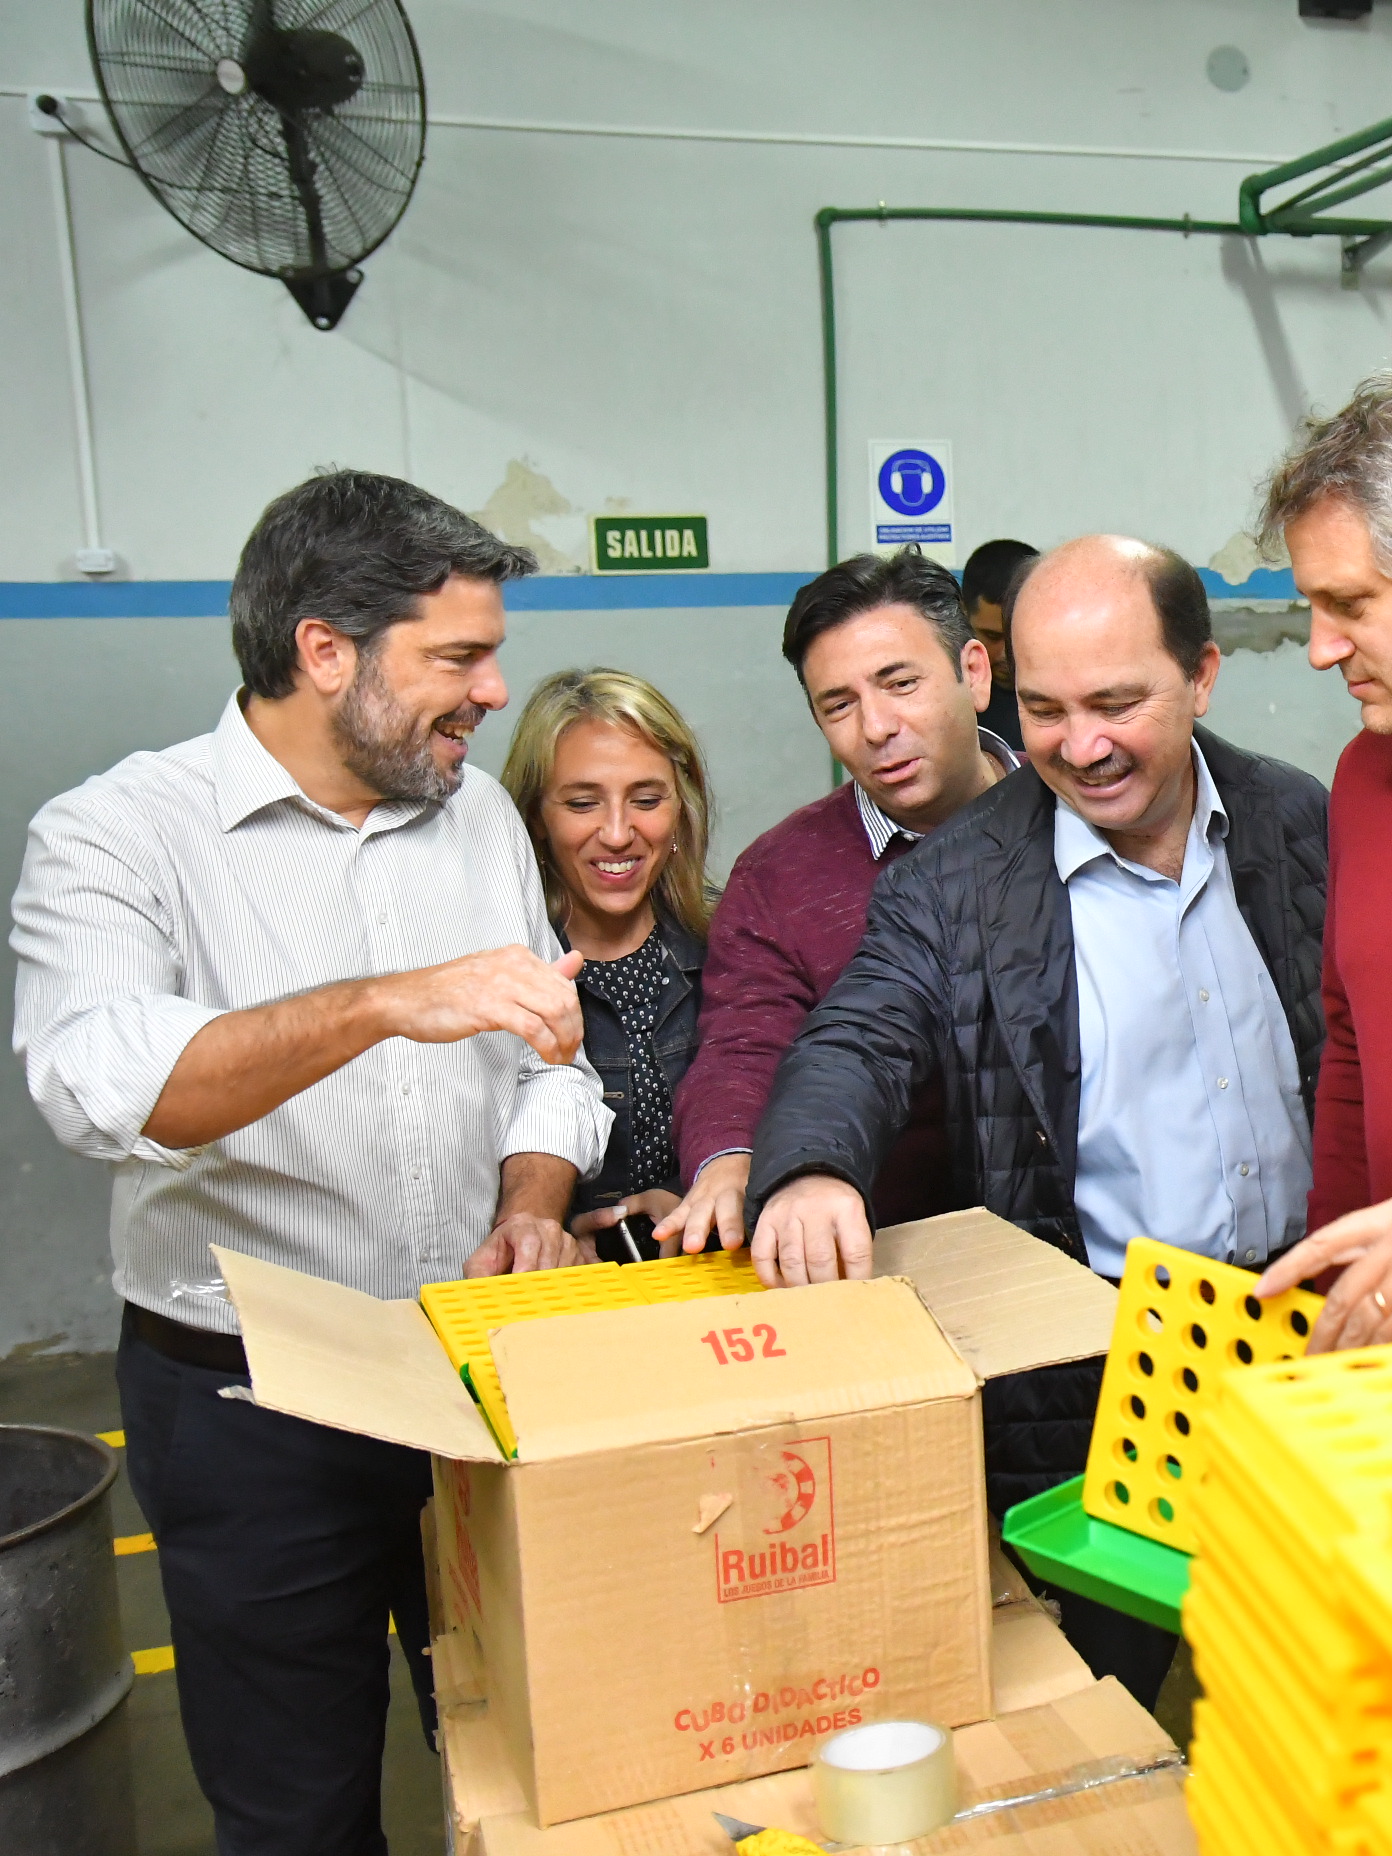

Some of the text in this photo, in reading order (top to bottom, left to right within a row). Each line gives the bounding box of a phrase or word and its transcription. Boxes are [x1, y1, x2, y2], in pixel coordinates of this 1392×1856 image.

[606, 528, 698, 558] SALIDA
[700, 1323, 787, 1365] 152
[722, 1533, 829, 1585] Ruibal
[774, 1577, 785, 1589] DE
[786, 1576, 797, 1586] LA
[674, 1667, 880, 1732] CUBO DIDACTICO
[699, 1707, 863, 1762] X 6 UNIDADES
